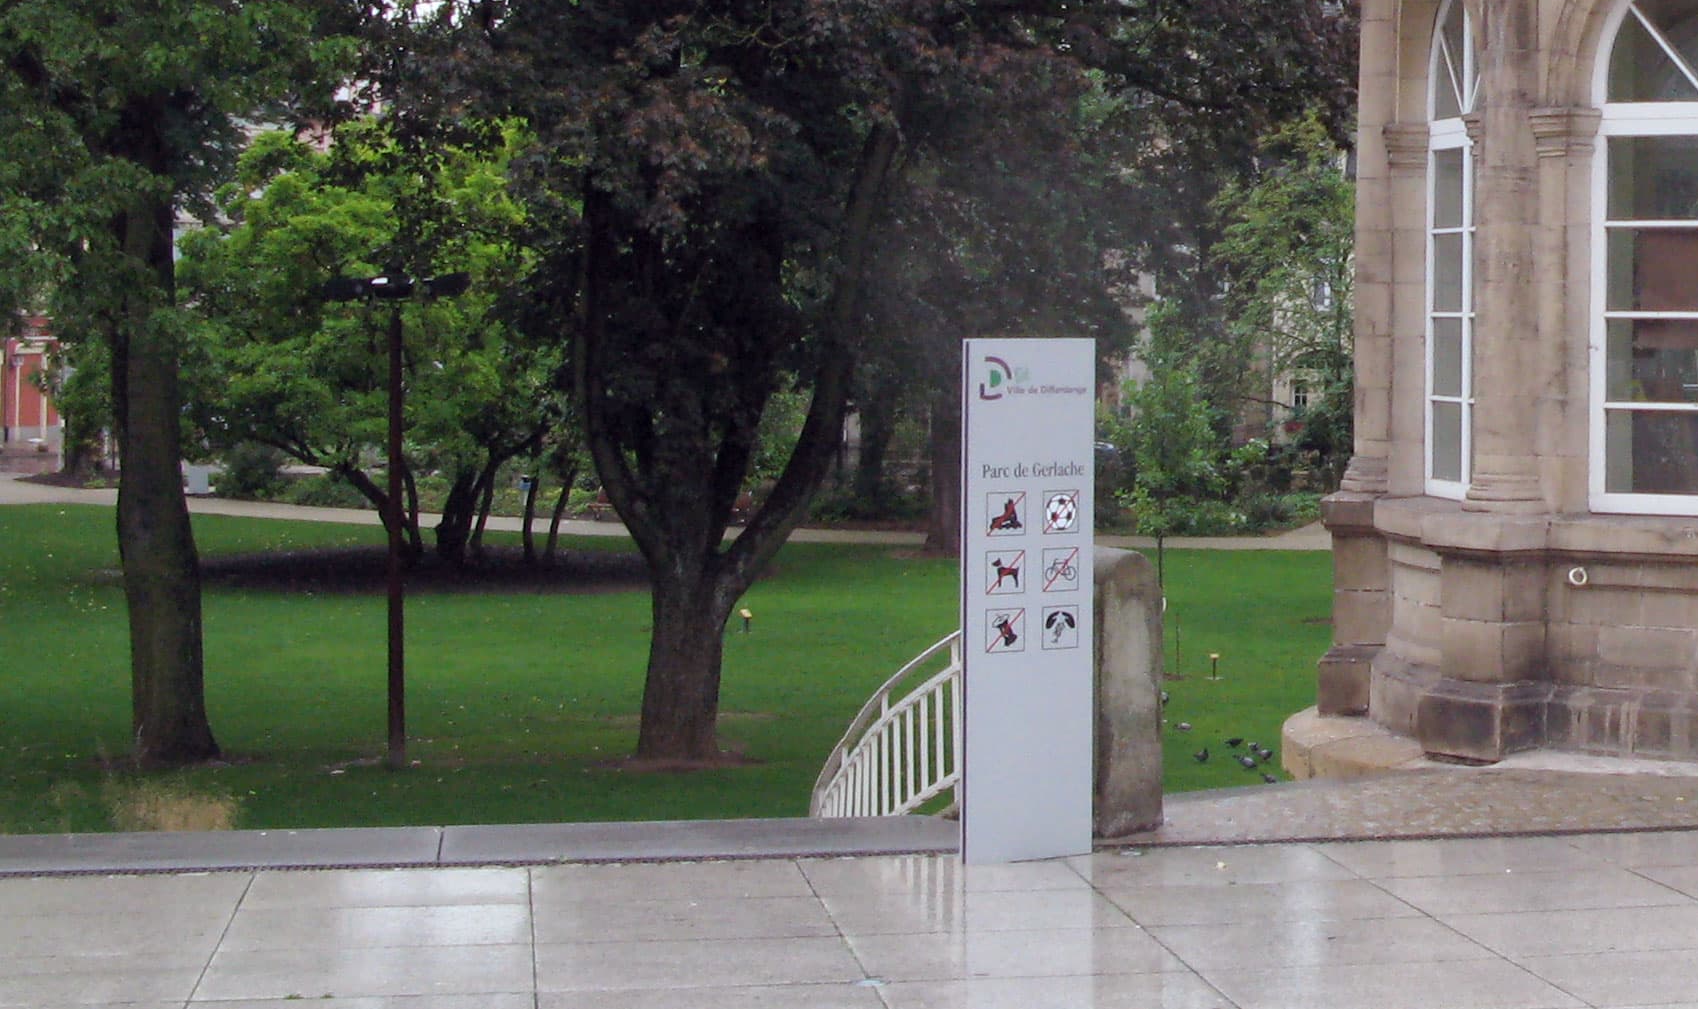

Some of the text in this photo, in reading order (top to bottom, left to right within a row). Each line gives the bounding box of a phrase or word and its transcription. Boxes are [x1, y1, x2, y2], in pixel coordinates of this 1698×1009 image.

[1007, 386, 1025, 394] Ville
[1028, 386, 1038, 394] de
[982, 460, 1085, 478] Parc de Gerlache
